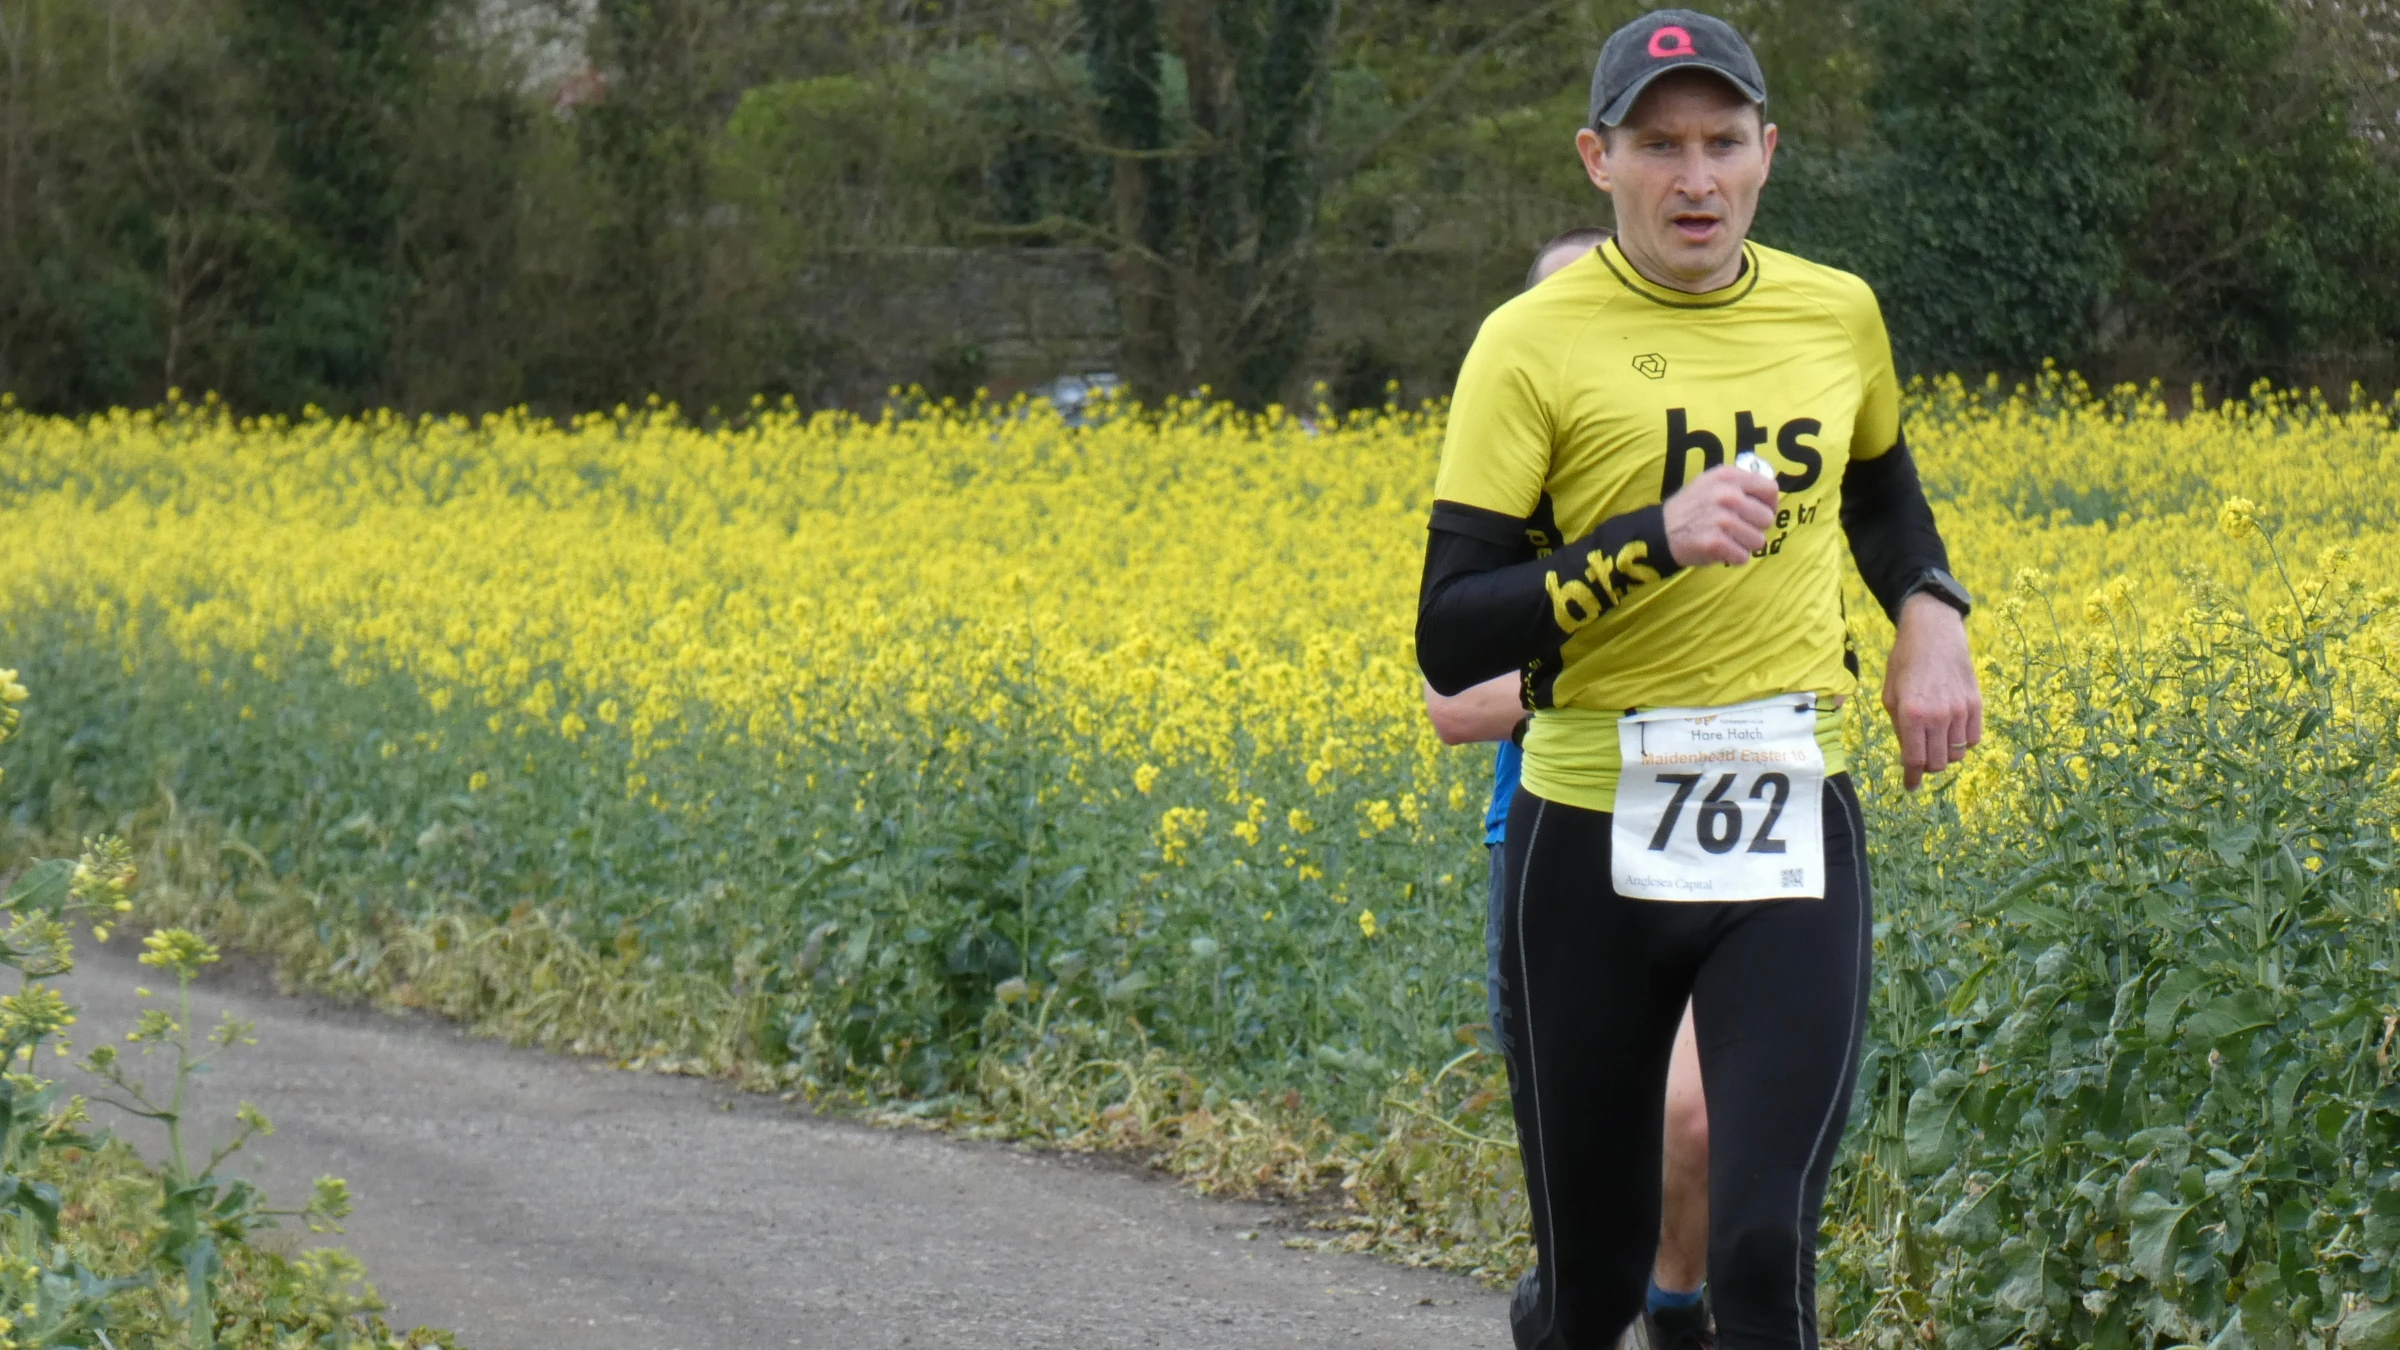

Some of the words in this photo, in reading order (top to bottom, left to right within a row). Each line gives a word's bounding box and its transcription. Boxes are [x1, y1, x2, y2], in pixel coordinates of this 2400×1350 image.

[1545, 540, 1662, 635] bts
[1691, 730, 1723, 741] Hare
[1727, 727, 1763, 740] Hatch
[1641, 749, 1735, 766] Maidenhead
[1741, 749, 1787, 763] Easter
[1791, 750, 1806, 762] 10
[1647, 772, 1790, 855] 762
[1675, 878, 1712, 892] Capital
